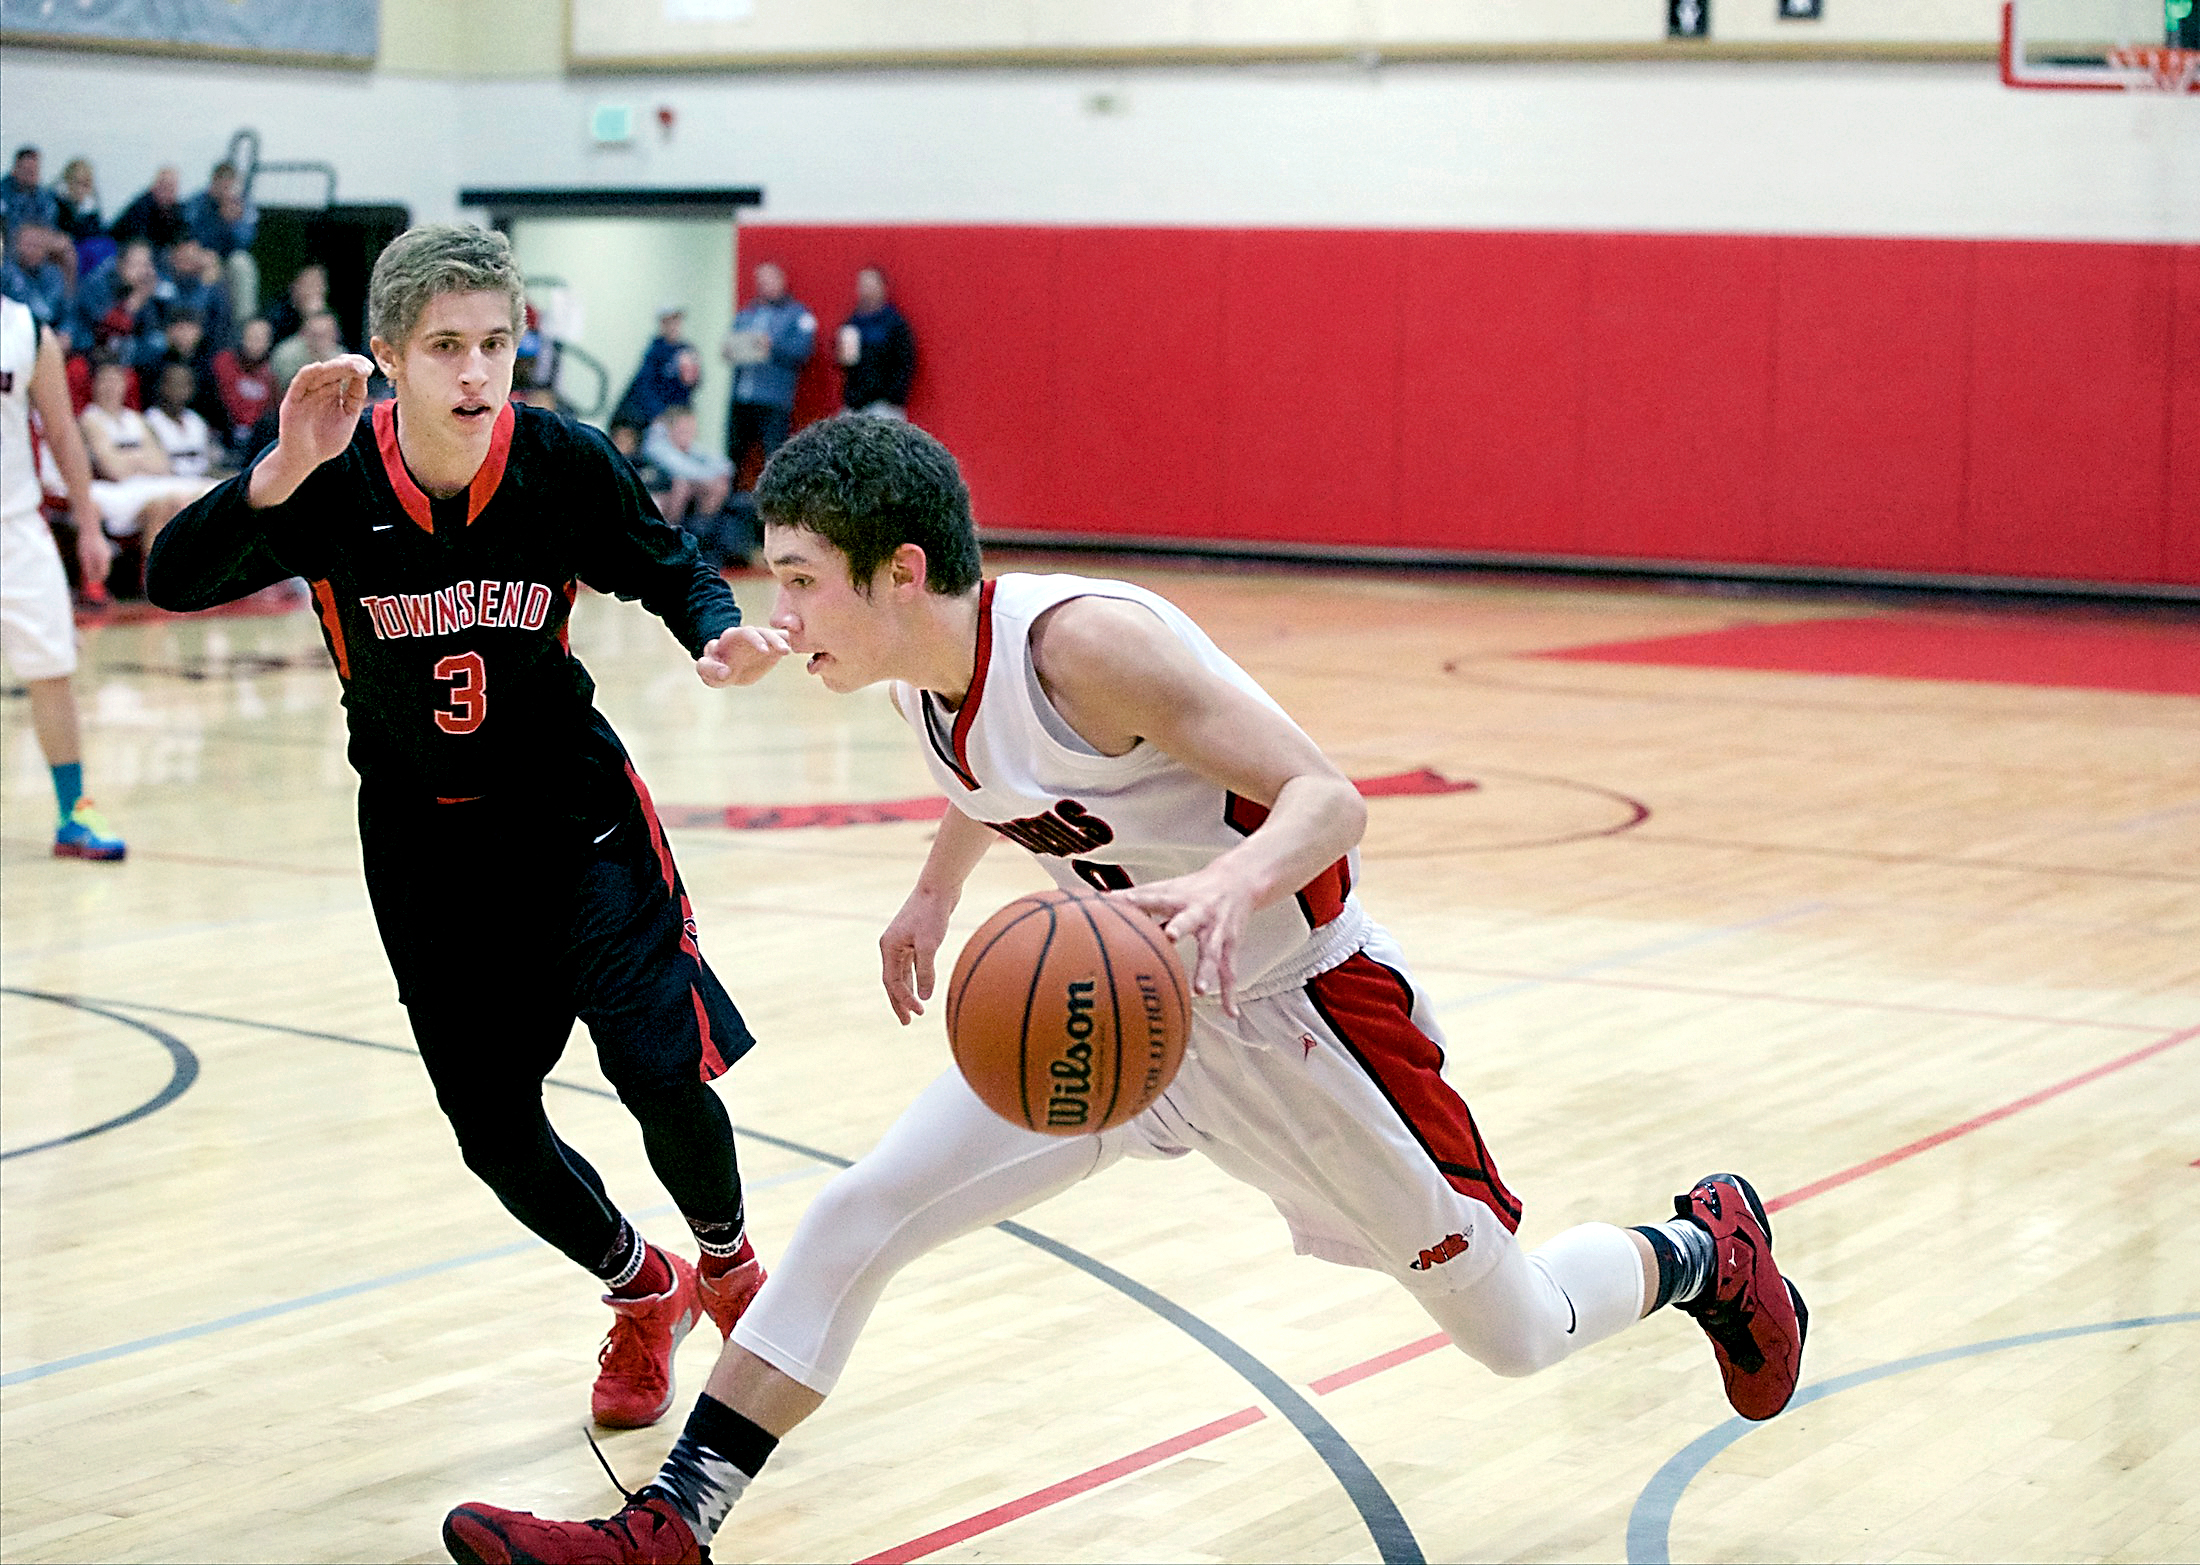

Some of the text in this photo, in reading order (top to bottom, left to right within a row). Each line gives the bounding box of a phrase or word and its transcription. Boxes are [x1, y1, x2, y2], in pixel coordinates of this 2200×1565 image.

[360, 580, 552, 640] TOWNSEND
[434, 651, 487, 735] 3
[1047, 981, 1095, 1126] Wilson
